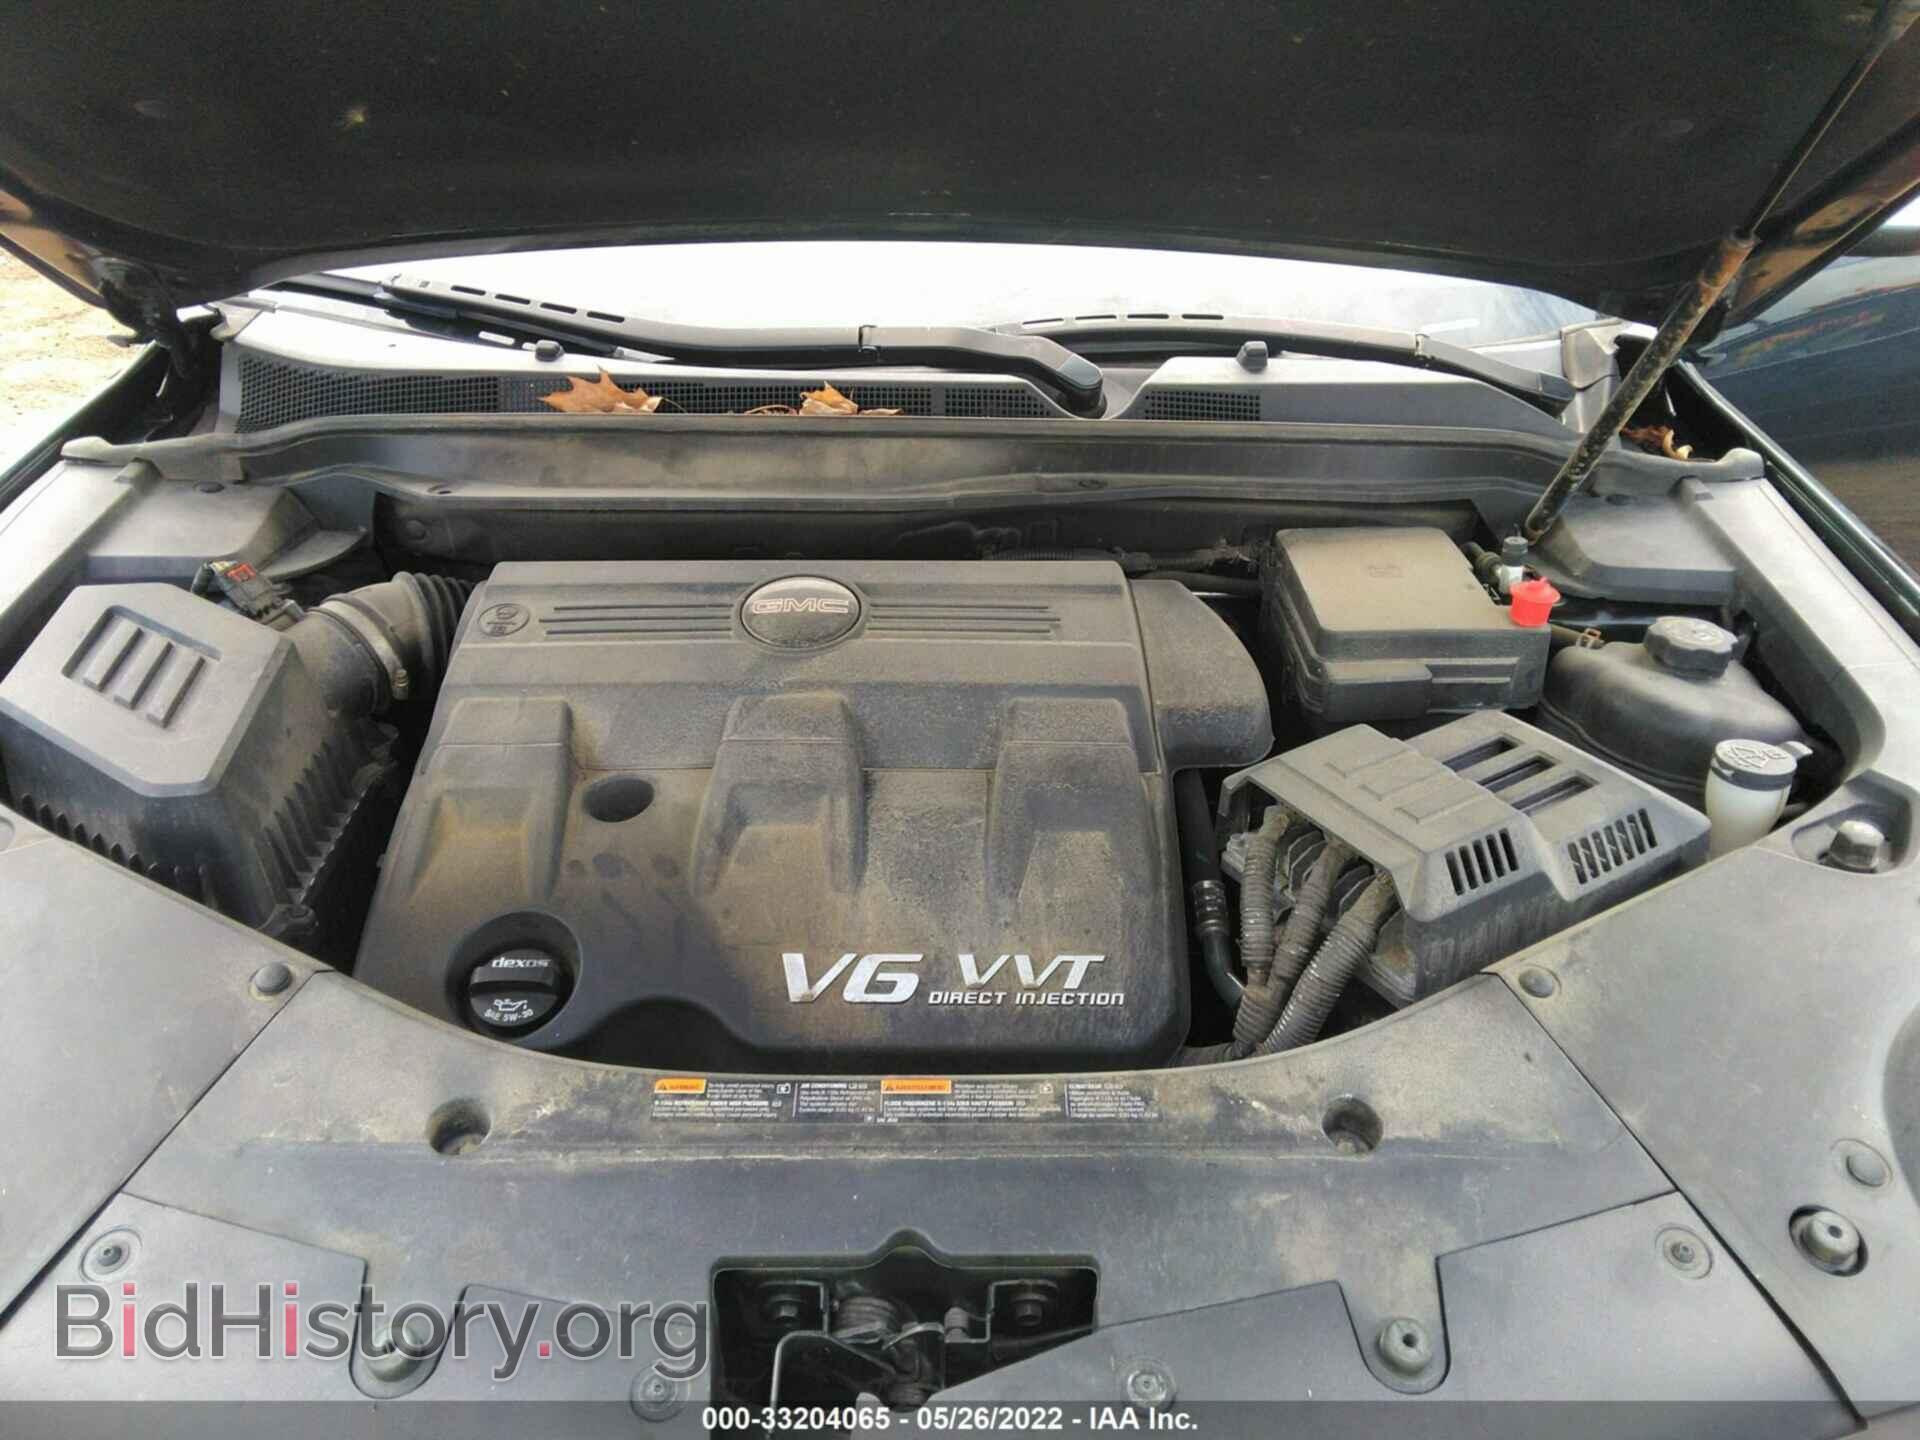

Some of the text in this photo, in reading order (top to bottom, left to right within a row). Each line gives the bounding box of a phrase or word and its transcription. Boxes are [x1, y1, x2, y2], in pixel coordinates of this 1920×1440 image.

[752, 598, 849, 614] GMC
[491, 957, 551, 969] dexos
[782, 953, 1107, 1003] V6 VVT
[928, 991, 1125, 1006] DIRECT INJECTION
